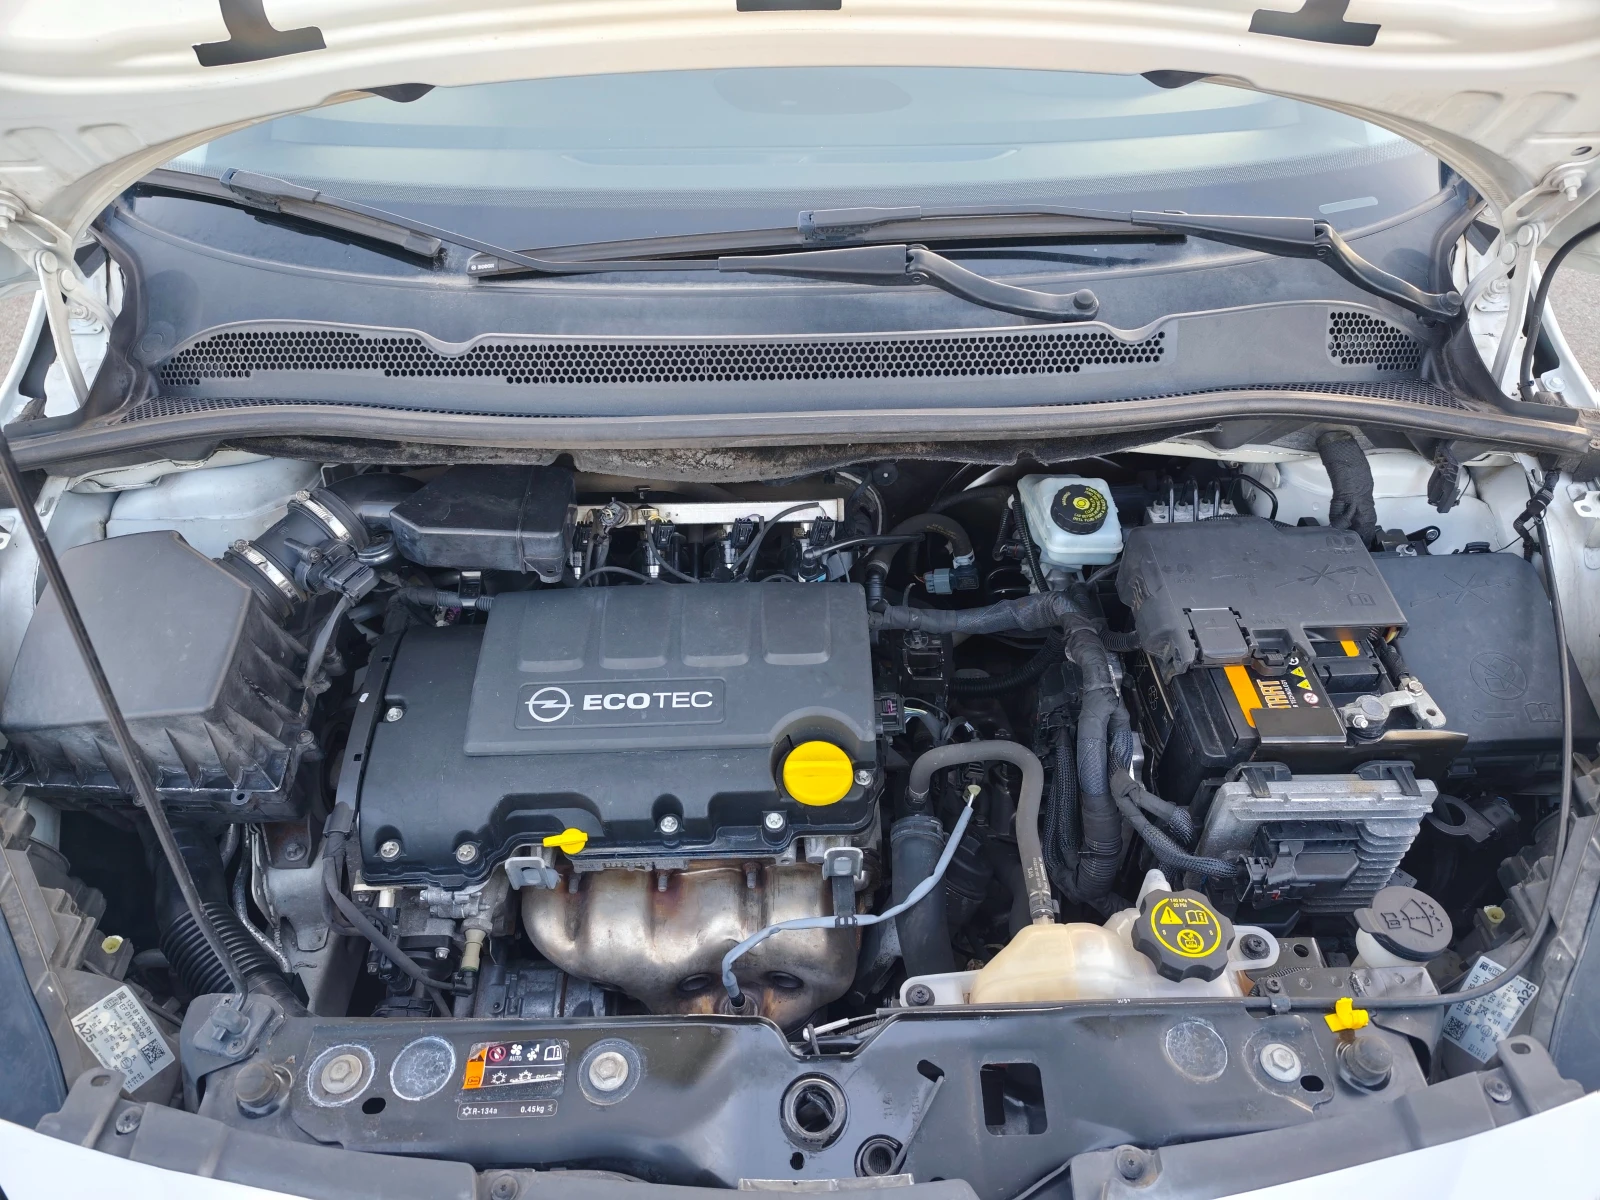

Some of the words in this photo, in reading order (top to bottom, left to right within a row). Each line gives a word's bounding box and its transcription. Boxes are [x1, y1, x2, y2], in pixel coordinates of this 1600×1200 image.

[583, 691, 713, 711] ECOTEC
[1256, 679, 1292, 709] TART
[1472, 974, 1480, 983] LH
[1487, 993, 1496, 1004] 12V
[1516, 983, 1536, 1005] A25
[125, 1011, 134, 1021] 011
[126, 999, 135, 1009] 133
[145, 1026, 153, 1035] RH
[75, 1021, 97, 1043] A25
[118, 1032, 128, 1043] 12V
[472, 1106, 498, 1115] R-134a
